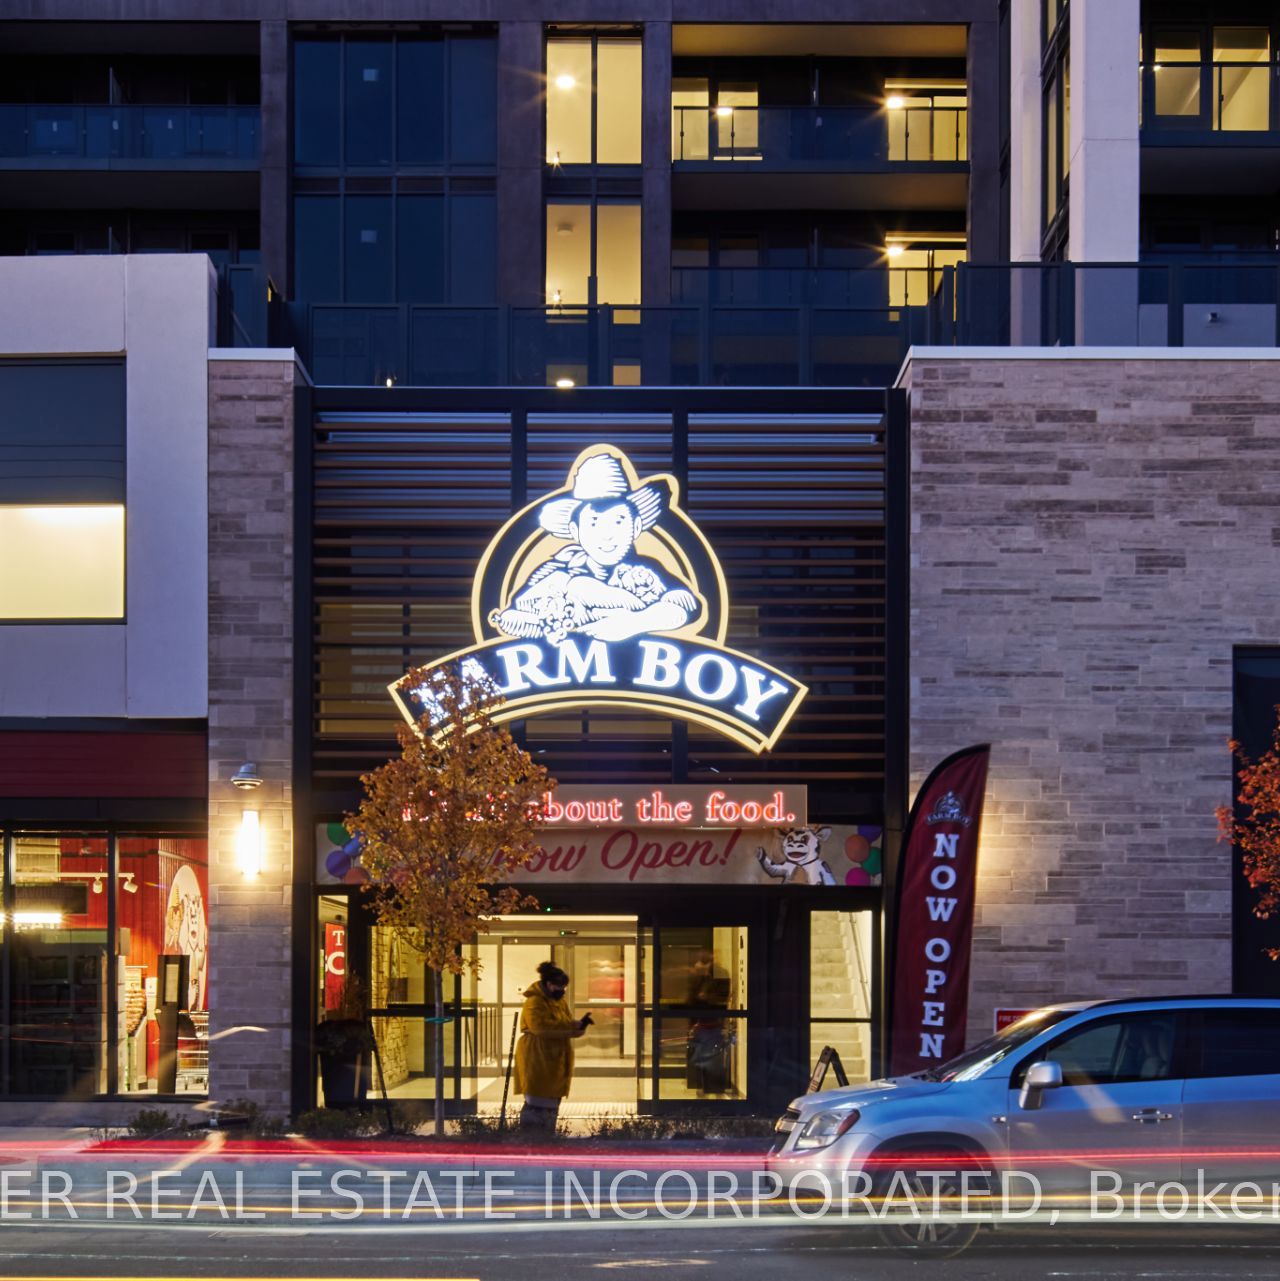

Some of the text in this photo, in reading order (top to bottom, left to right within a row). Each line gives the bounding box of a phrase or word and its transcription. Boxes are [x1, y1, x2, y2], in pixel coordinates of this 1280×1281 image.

[633, 639, 789, 721] BOY
[637, 791, 692, 822] the
[706, 791, 796, 822] food.
[600, 828, 743, 881] Open!
[919, 833, 959, 1059] NOW OPEN
